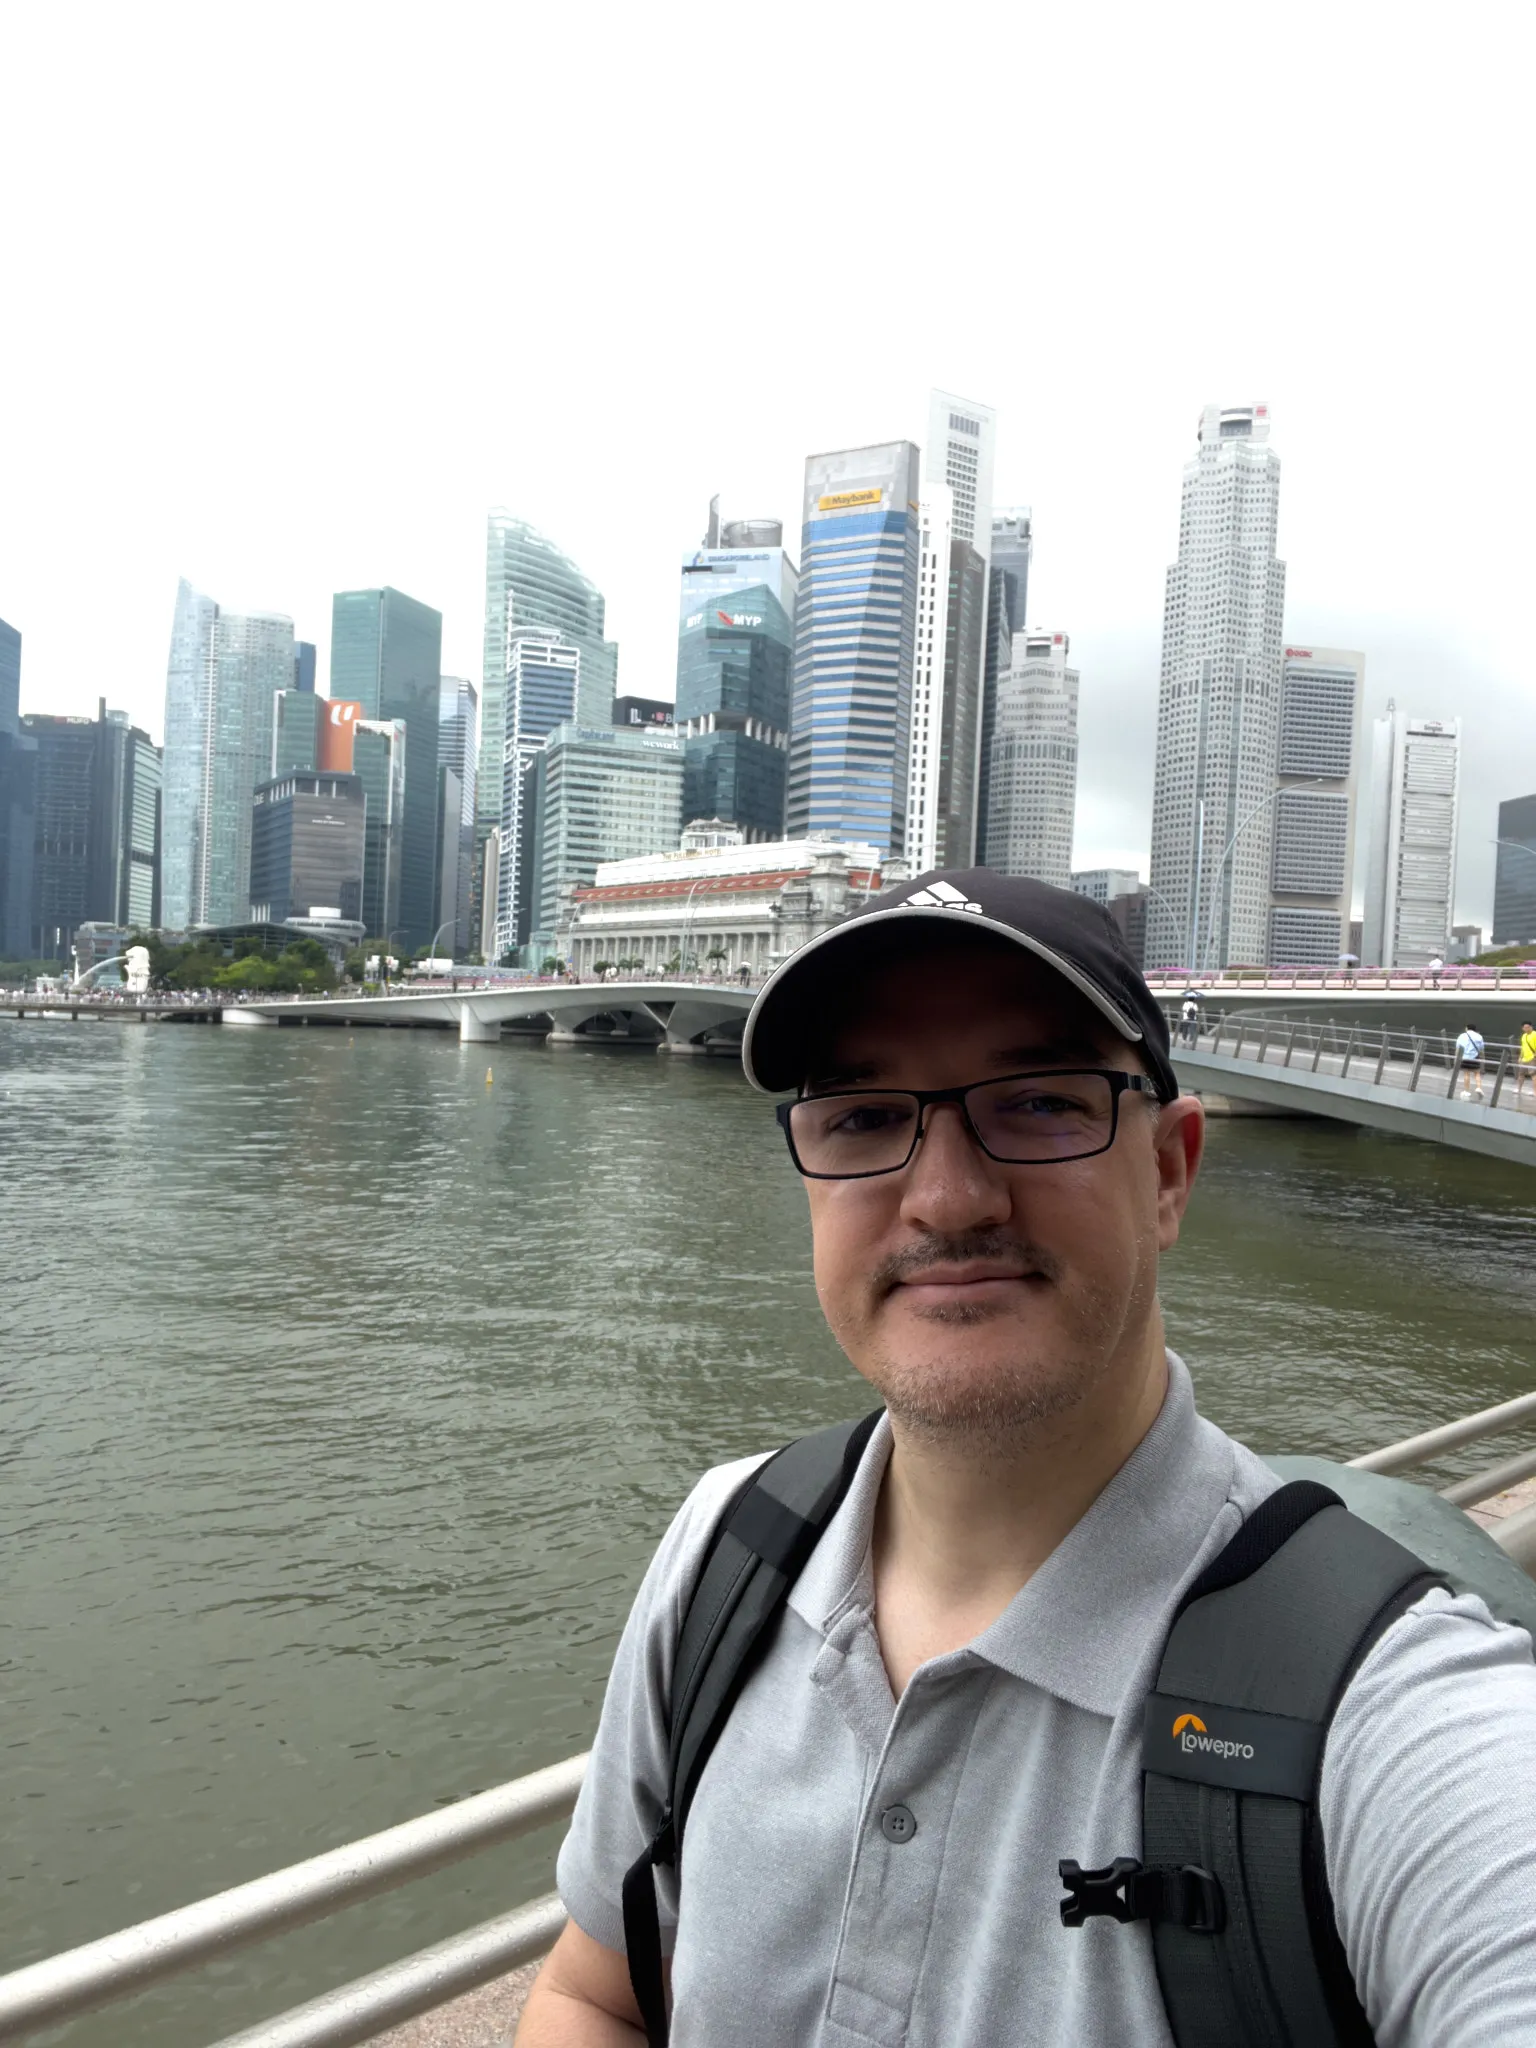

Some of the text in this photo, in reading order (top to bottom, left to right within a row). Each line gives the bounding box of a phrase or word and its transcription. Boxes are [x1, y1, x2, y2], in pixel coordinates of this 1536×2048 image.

[832, 491, 875, 505] Maybank
[733, 614, 761, 627] MYP
[1182, 1731, 1254, 1759] Lowepro
